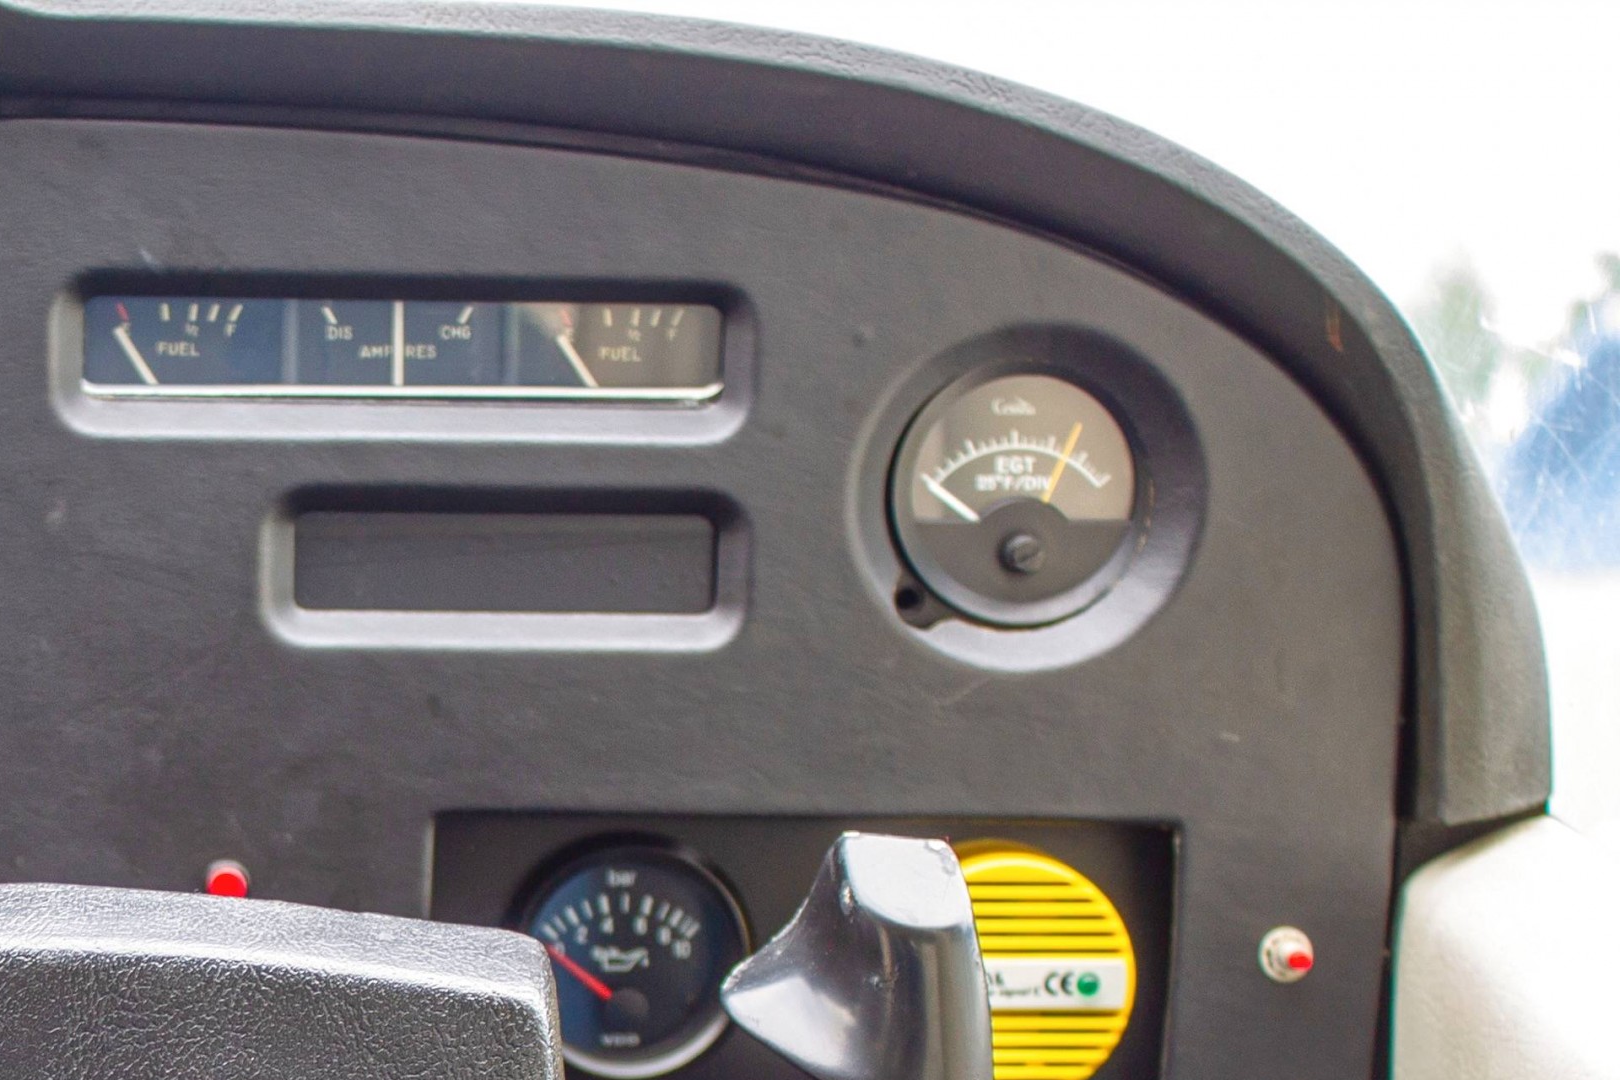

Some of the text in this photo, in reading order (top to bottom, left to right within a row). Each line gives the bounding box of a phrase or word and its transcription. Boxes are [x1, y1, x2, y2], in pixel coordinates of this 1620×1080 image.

[325, 325, 353, 341] DIS
[439, 324, 472, 341] CHG
[156, 341, 200, 357] FUEL
[599, 346, 642, 362] FUEL
[995, 455, 1035, 475] EGT
[606, 870, 637, 887] bar
